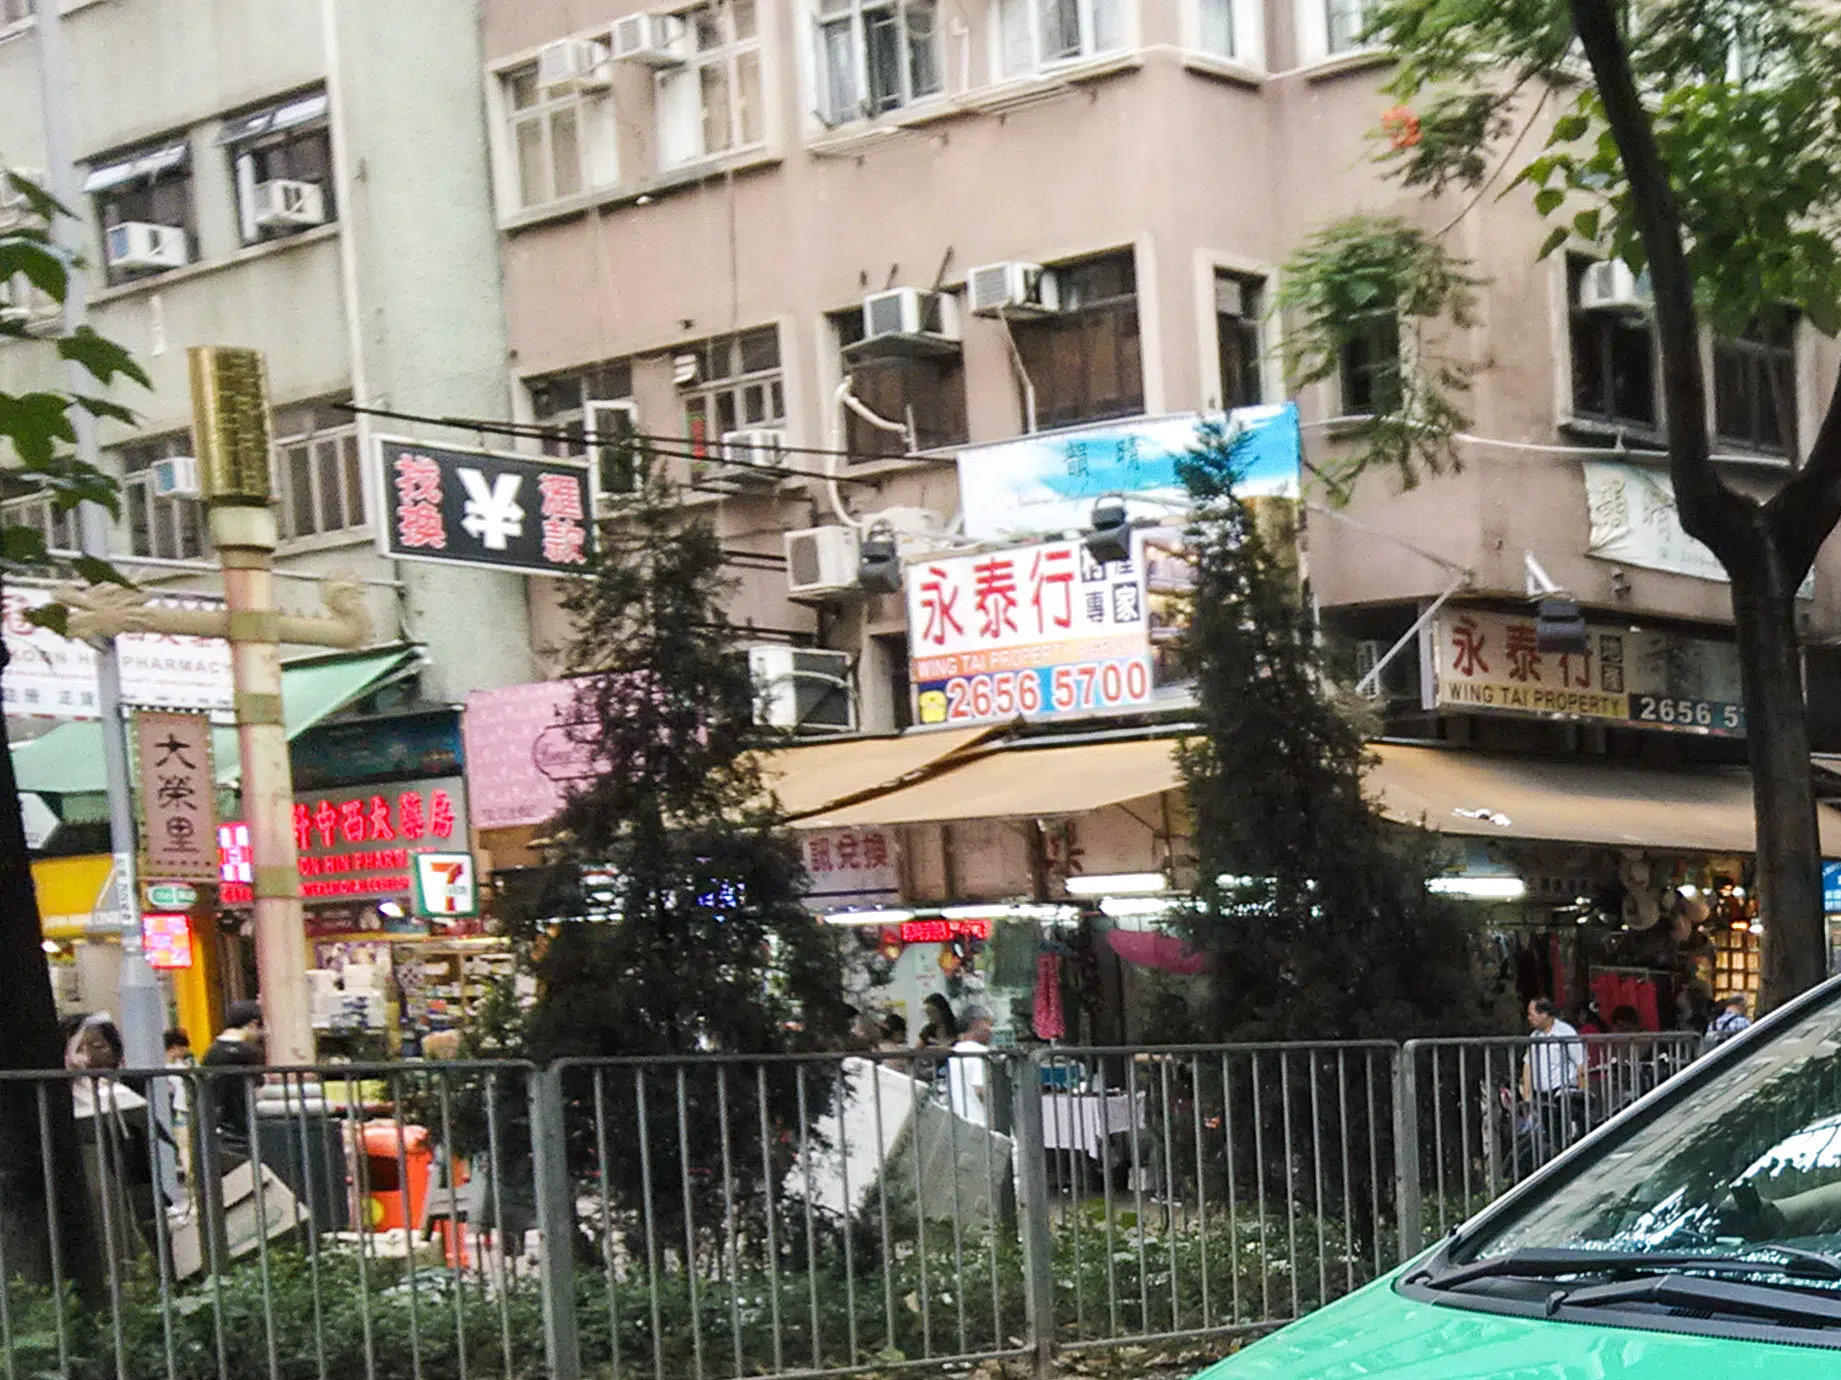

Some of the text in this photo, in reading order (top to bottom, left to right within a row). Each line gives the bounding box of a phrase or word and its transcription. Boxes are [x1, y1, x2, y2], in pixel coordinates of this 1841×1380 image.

[457, 467, 525, 549] ¥
[919, 550, 1076, 645] 永泰行
[918, 656, 957, 678] WING
[962, 652, 988, 672] TAI
[1452, 614, 1593, 688] 永泰行
[948, 659, 1149, 720] 2656 5700
[1450, 683, 1620, 715] WING TAI PROPERTY
[1640, 697, 1746, 728] 2656 5
[154, 733, 199, 853] 大榮里
